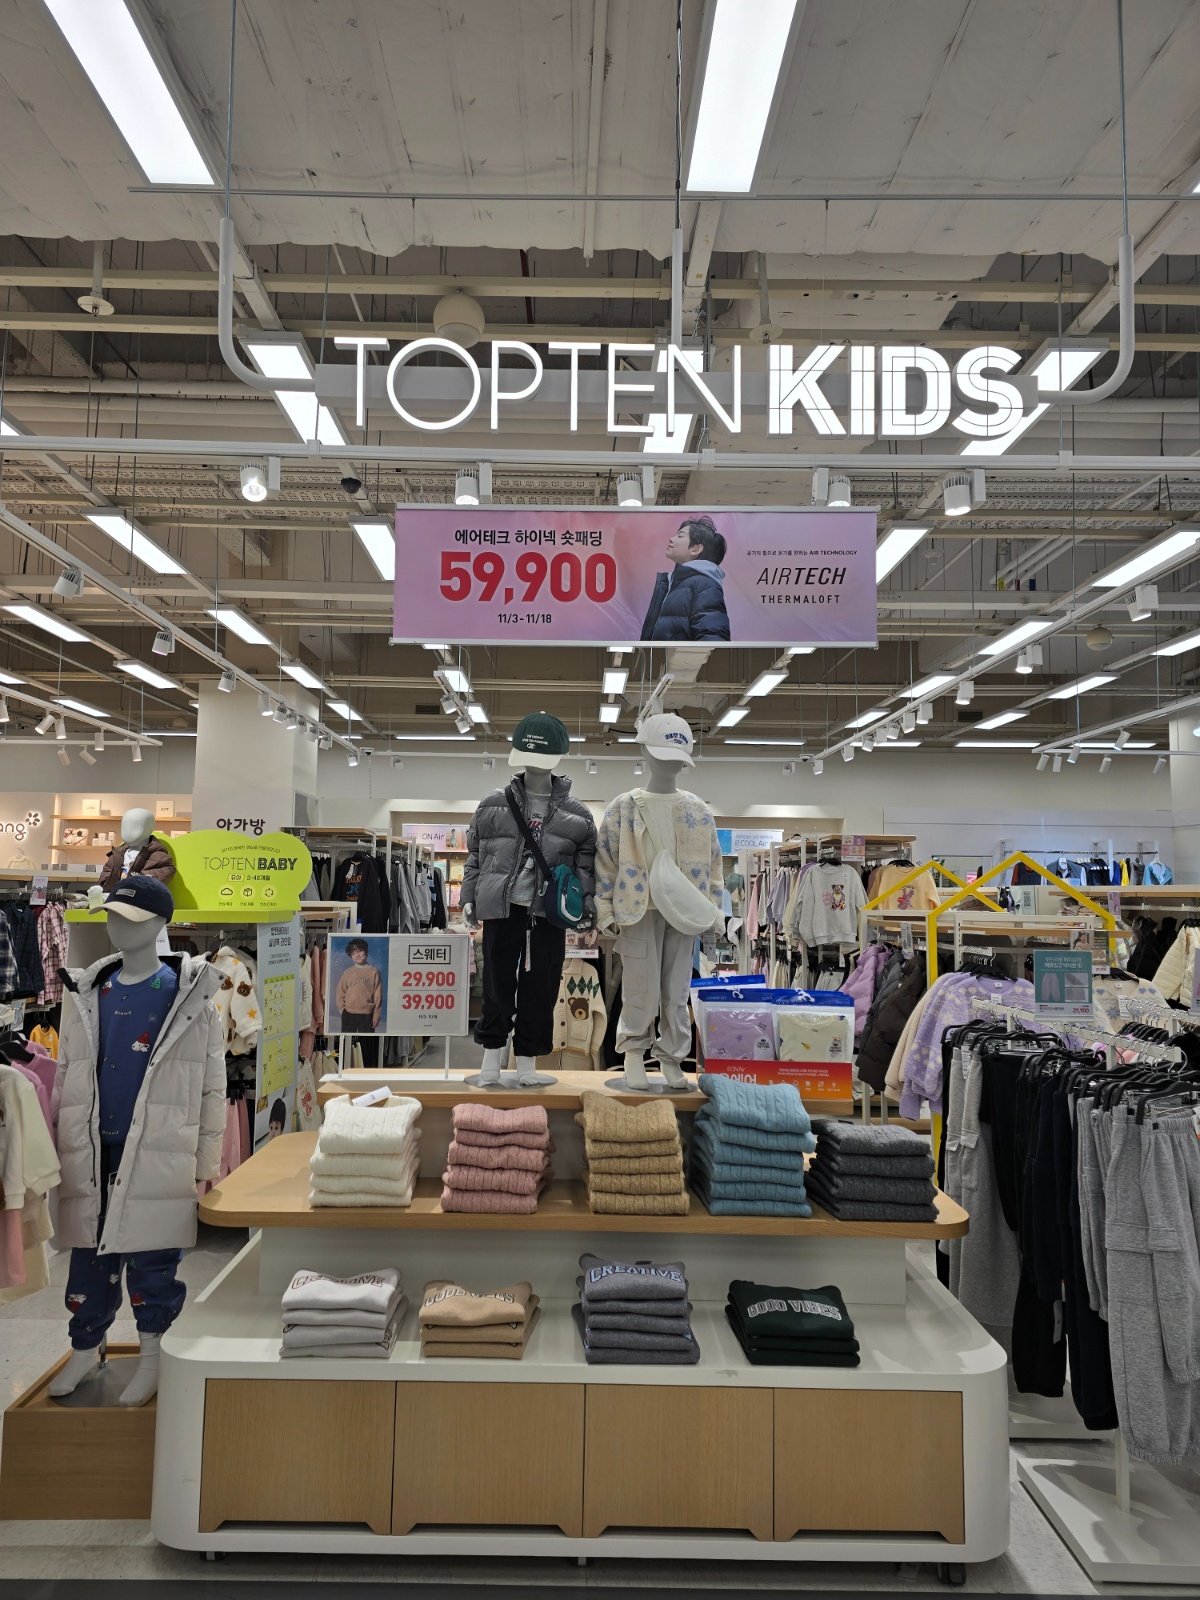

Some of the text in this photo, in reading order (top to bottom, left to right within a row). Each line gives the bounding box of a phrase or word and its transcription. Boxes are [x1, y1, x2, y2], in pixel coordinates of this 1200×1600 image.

[333, 336, 1025, 438] TOPTEN KIDS
[454, 529, 603, 547] 에어테크 하이넥 숏패딩
[439, 551, 617, 606] 59,900
[756, 567, 847, 585] AIRTECH
[761, 595, 841, 604] THERMALOFT
[216, 818, 266, 836] 아가방
[202, 857, 298, 871] TOPTEN BABY
[412, 948, 447, 961] 스웨터
[402, 971, 456, 988] 29,900
[401, 994, 455, 1010] 39,900
[590, 1265, 683, 1283] CREATIVE
[747, 1299, 843, 1321] GOOD VIBES
